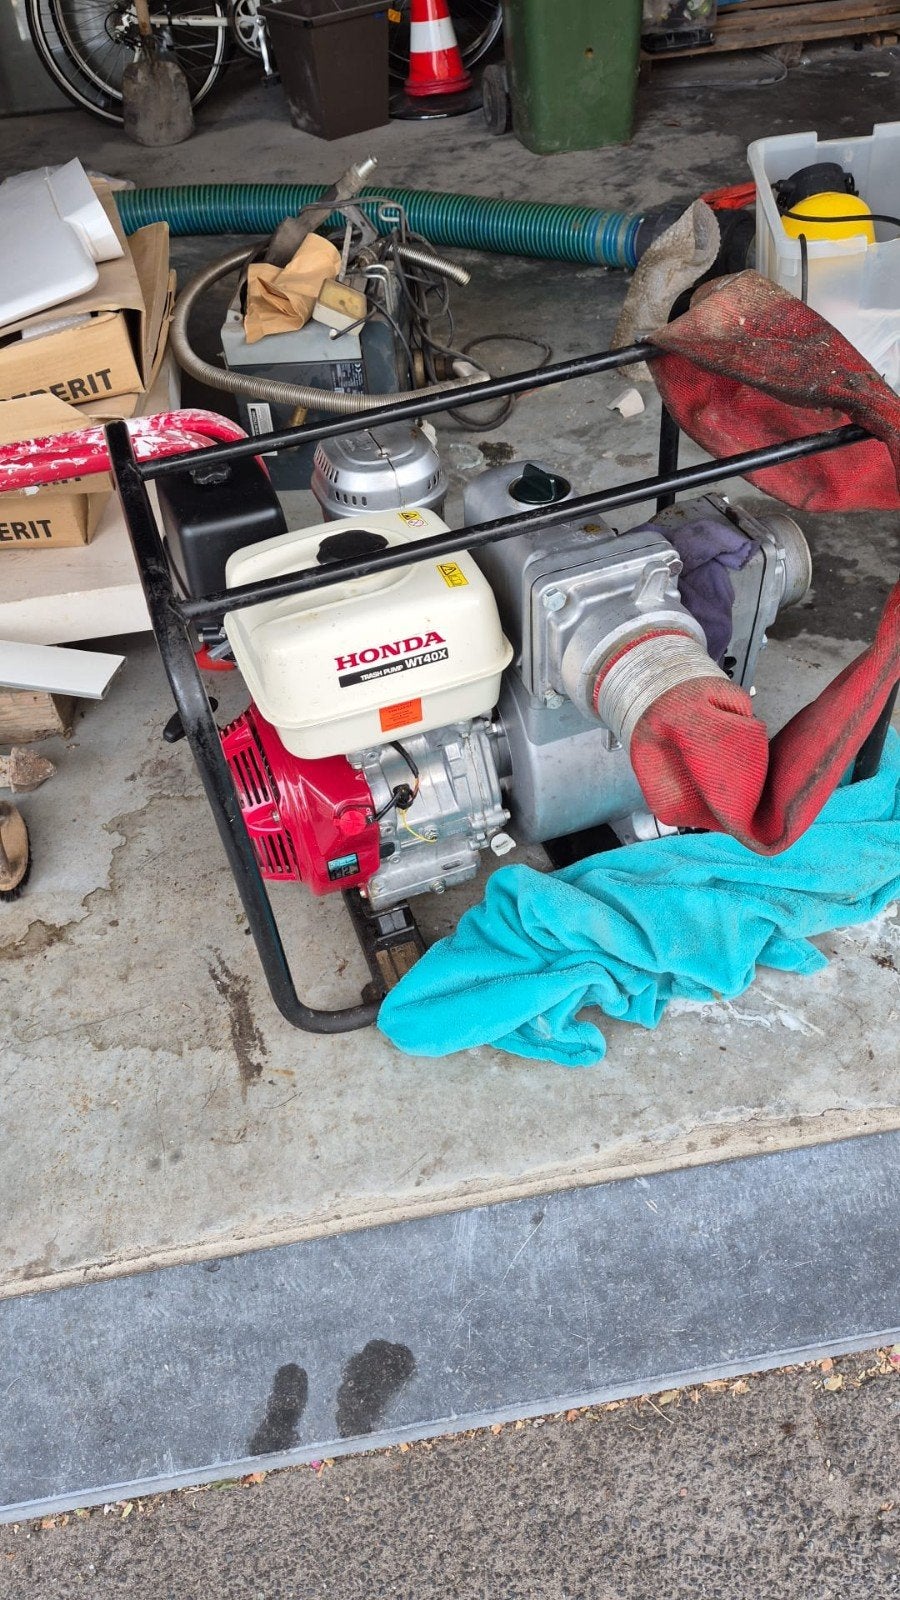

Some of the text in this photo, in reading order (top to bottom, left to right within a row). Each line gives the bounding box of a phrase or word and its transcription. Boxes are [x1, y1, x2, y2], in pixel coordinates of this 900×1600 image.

[0, 368, 112, 402] ERIT
[334, 631, 446, 671] HONDA
[360, 649, 448, 681] TRASH PUMP WT40X
